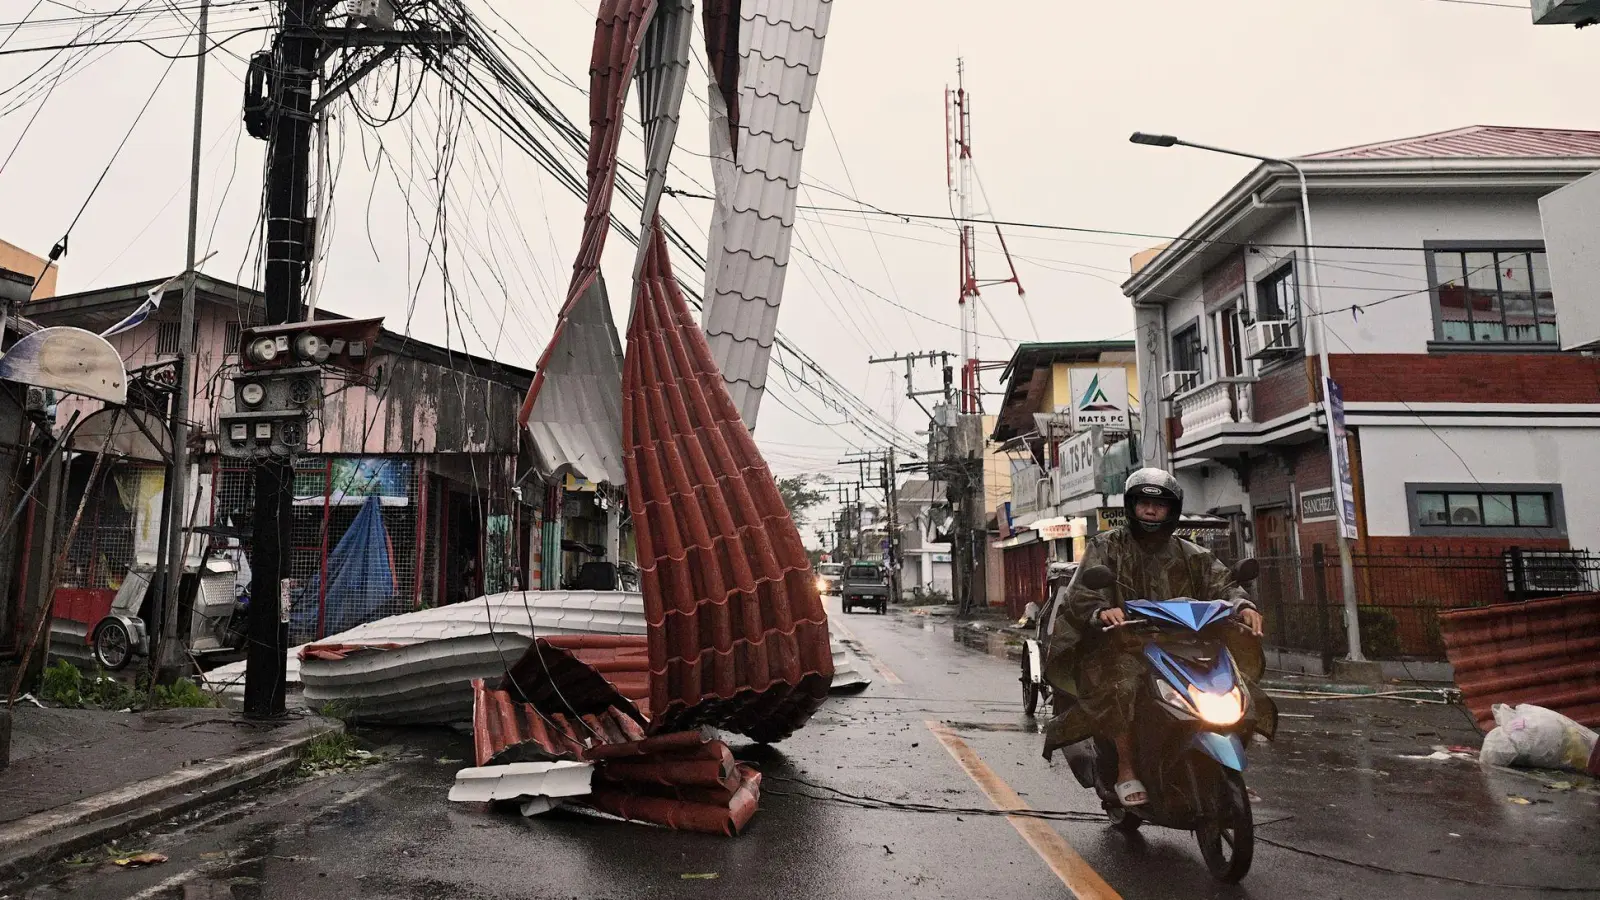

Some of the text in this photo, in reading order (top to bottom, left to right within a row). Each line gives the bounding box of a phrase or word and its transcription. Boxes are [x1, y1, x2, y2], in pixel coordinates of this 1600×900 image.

[1079, 415, 1123, 423] MATS PC
[1081, 437, 1092, 469] PC
[1303, 497, 1331, 514] SANCHEZ
